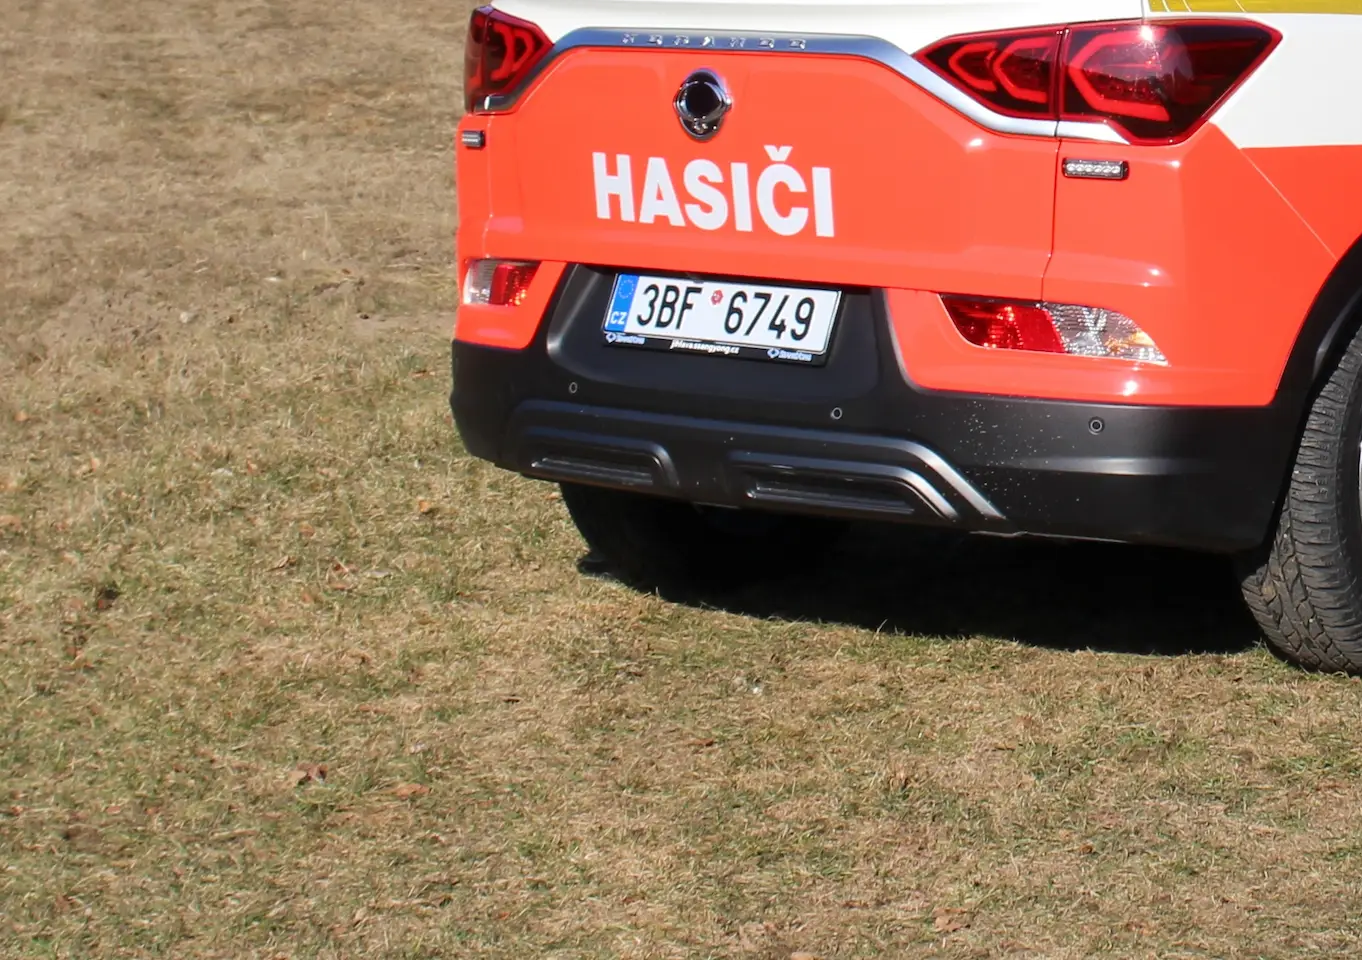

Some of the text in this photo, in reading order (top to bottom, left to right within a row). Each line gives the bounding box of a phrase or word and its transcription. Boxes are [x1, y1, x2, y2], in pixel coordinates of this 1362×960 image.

[592, 144, 835, 238] HASIČI
[610, 310, 627, 325] CZ
[636, 283, 815, 341] 3BF 6749
